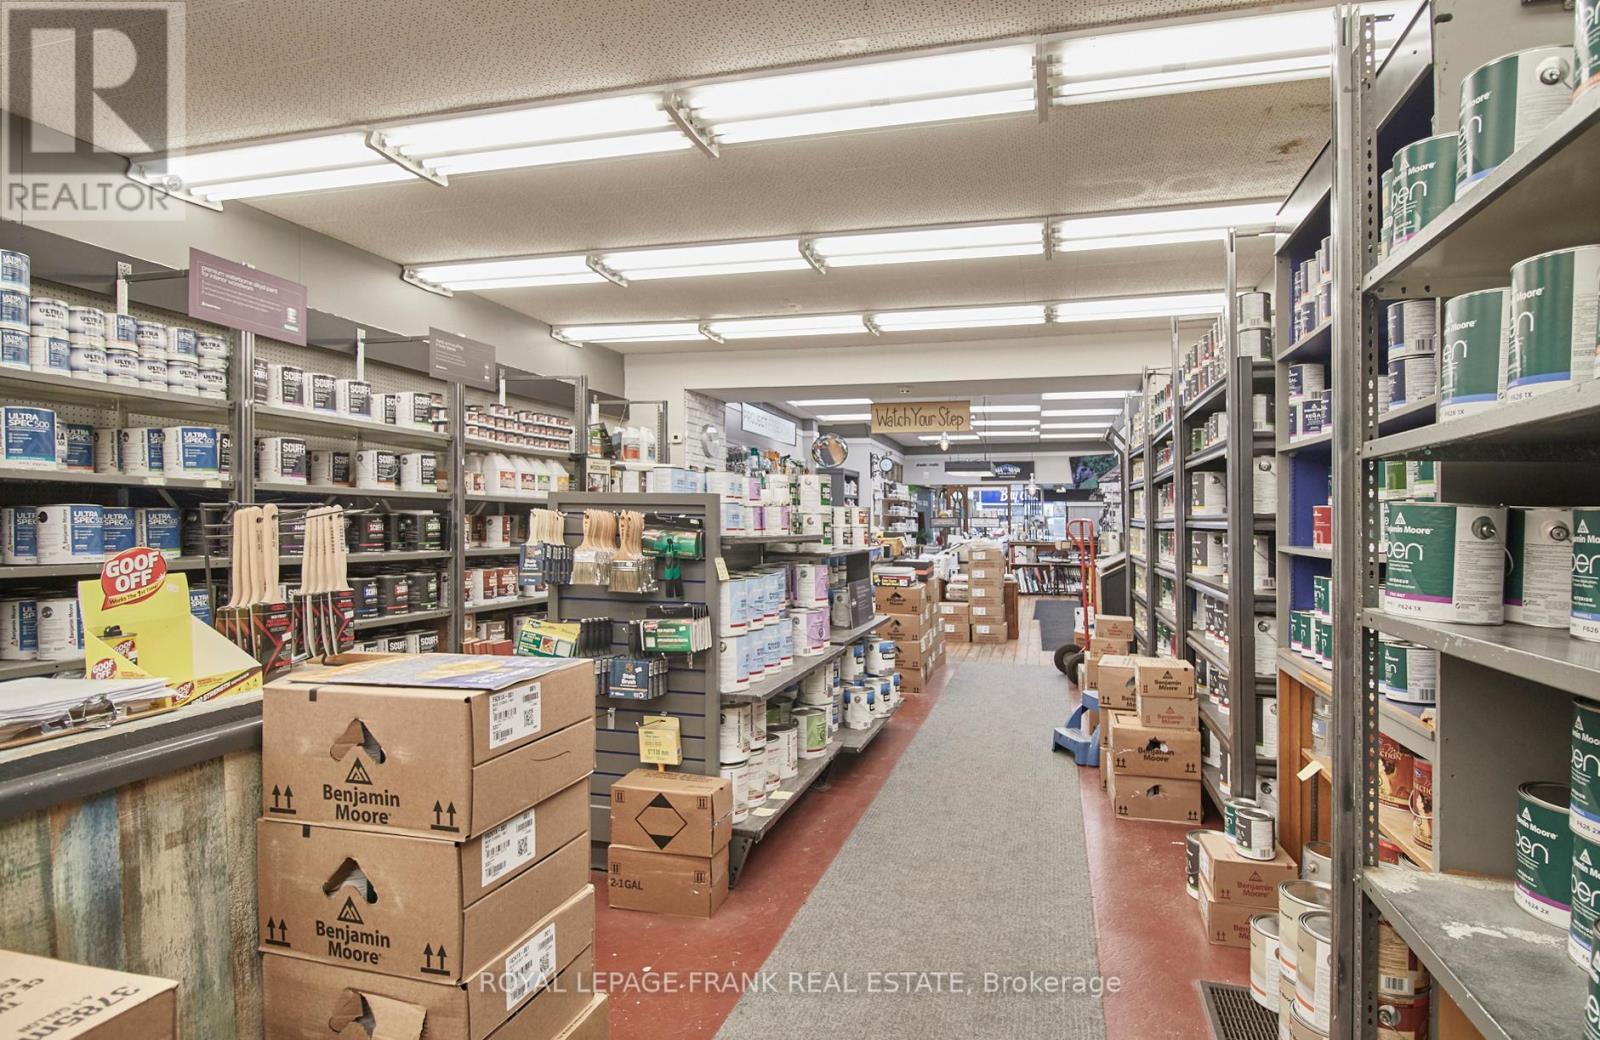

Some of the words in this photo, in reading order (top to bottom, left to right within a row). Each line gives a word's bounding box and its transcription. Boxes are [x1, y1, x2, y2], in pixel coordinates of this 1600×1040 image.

[1408, 162, 1437, 176] Moore
[8, 412, 39, 421] ULTRA
[876, 407, 911, 428] Watch
[911, 407, 937, 427] Your
[938, 406, 964, 431] Step
[34, 420, 50, 429] 500
[183, 431, 207, 439] ULTRA
[73, 510, 98, 518] ULTRA
[73, 516, 95, 524] SPEC
[1403, 526, 1433, 535] Moore
[105, 551, 160, 578] GOOF
[115, 568, 153, 592] OFF
[109, 595, 127, 605] Works
[92, 659, 114, 674] GOOF
[95, 667, 112, 680] OFF
[1582, 732, 1600, 746] Moo
[1143, 754, 1171, 763] Moore
[323, 784, 400, 808] Benjamin
[335, 803, 390, 826] Moore
[1530, 823, 1558, 841] Moore
[1237, 881, 1274, 893] Benjamin
[1242, 889, 1270, 899] Moore
[316, 920, 391, 949] Benjamin
[328, 942, 380, 965] Moore
